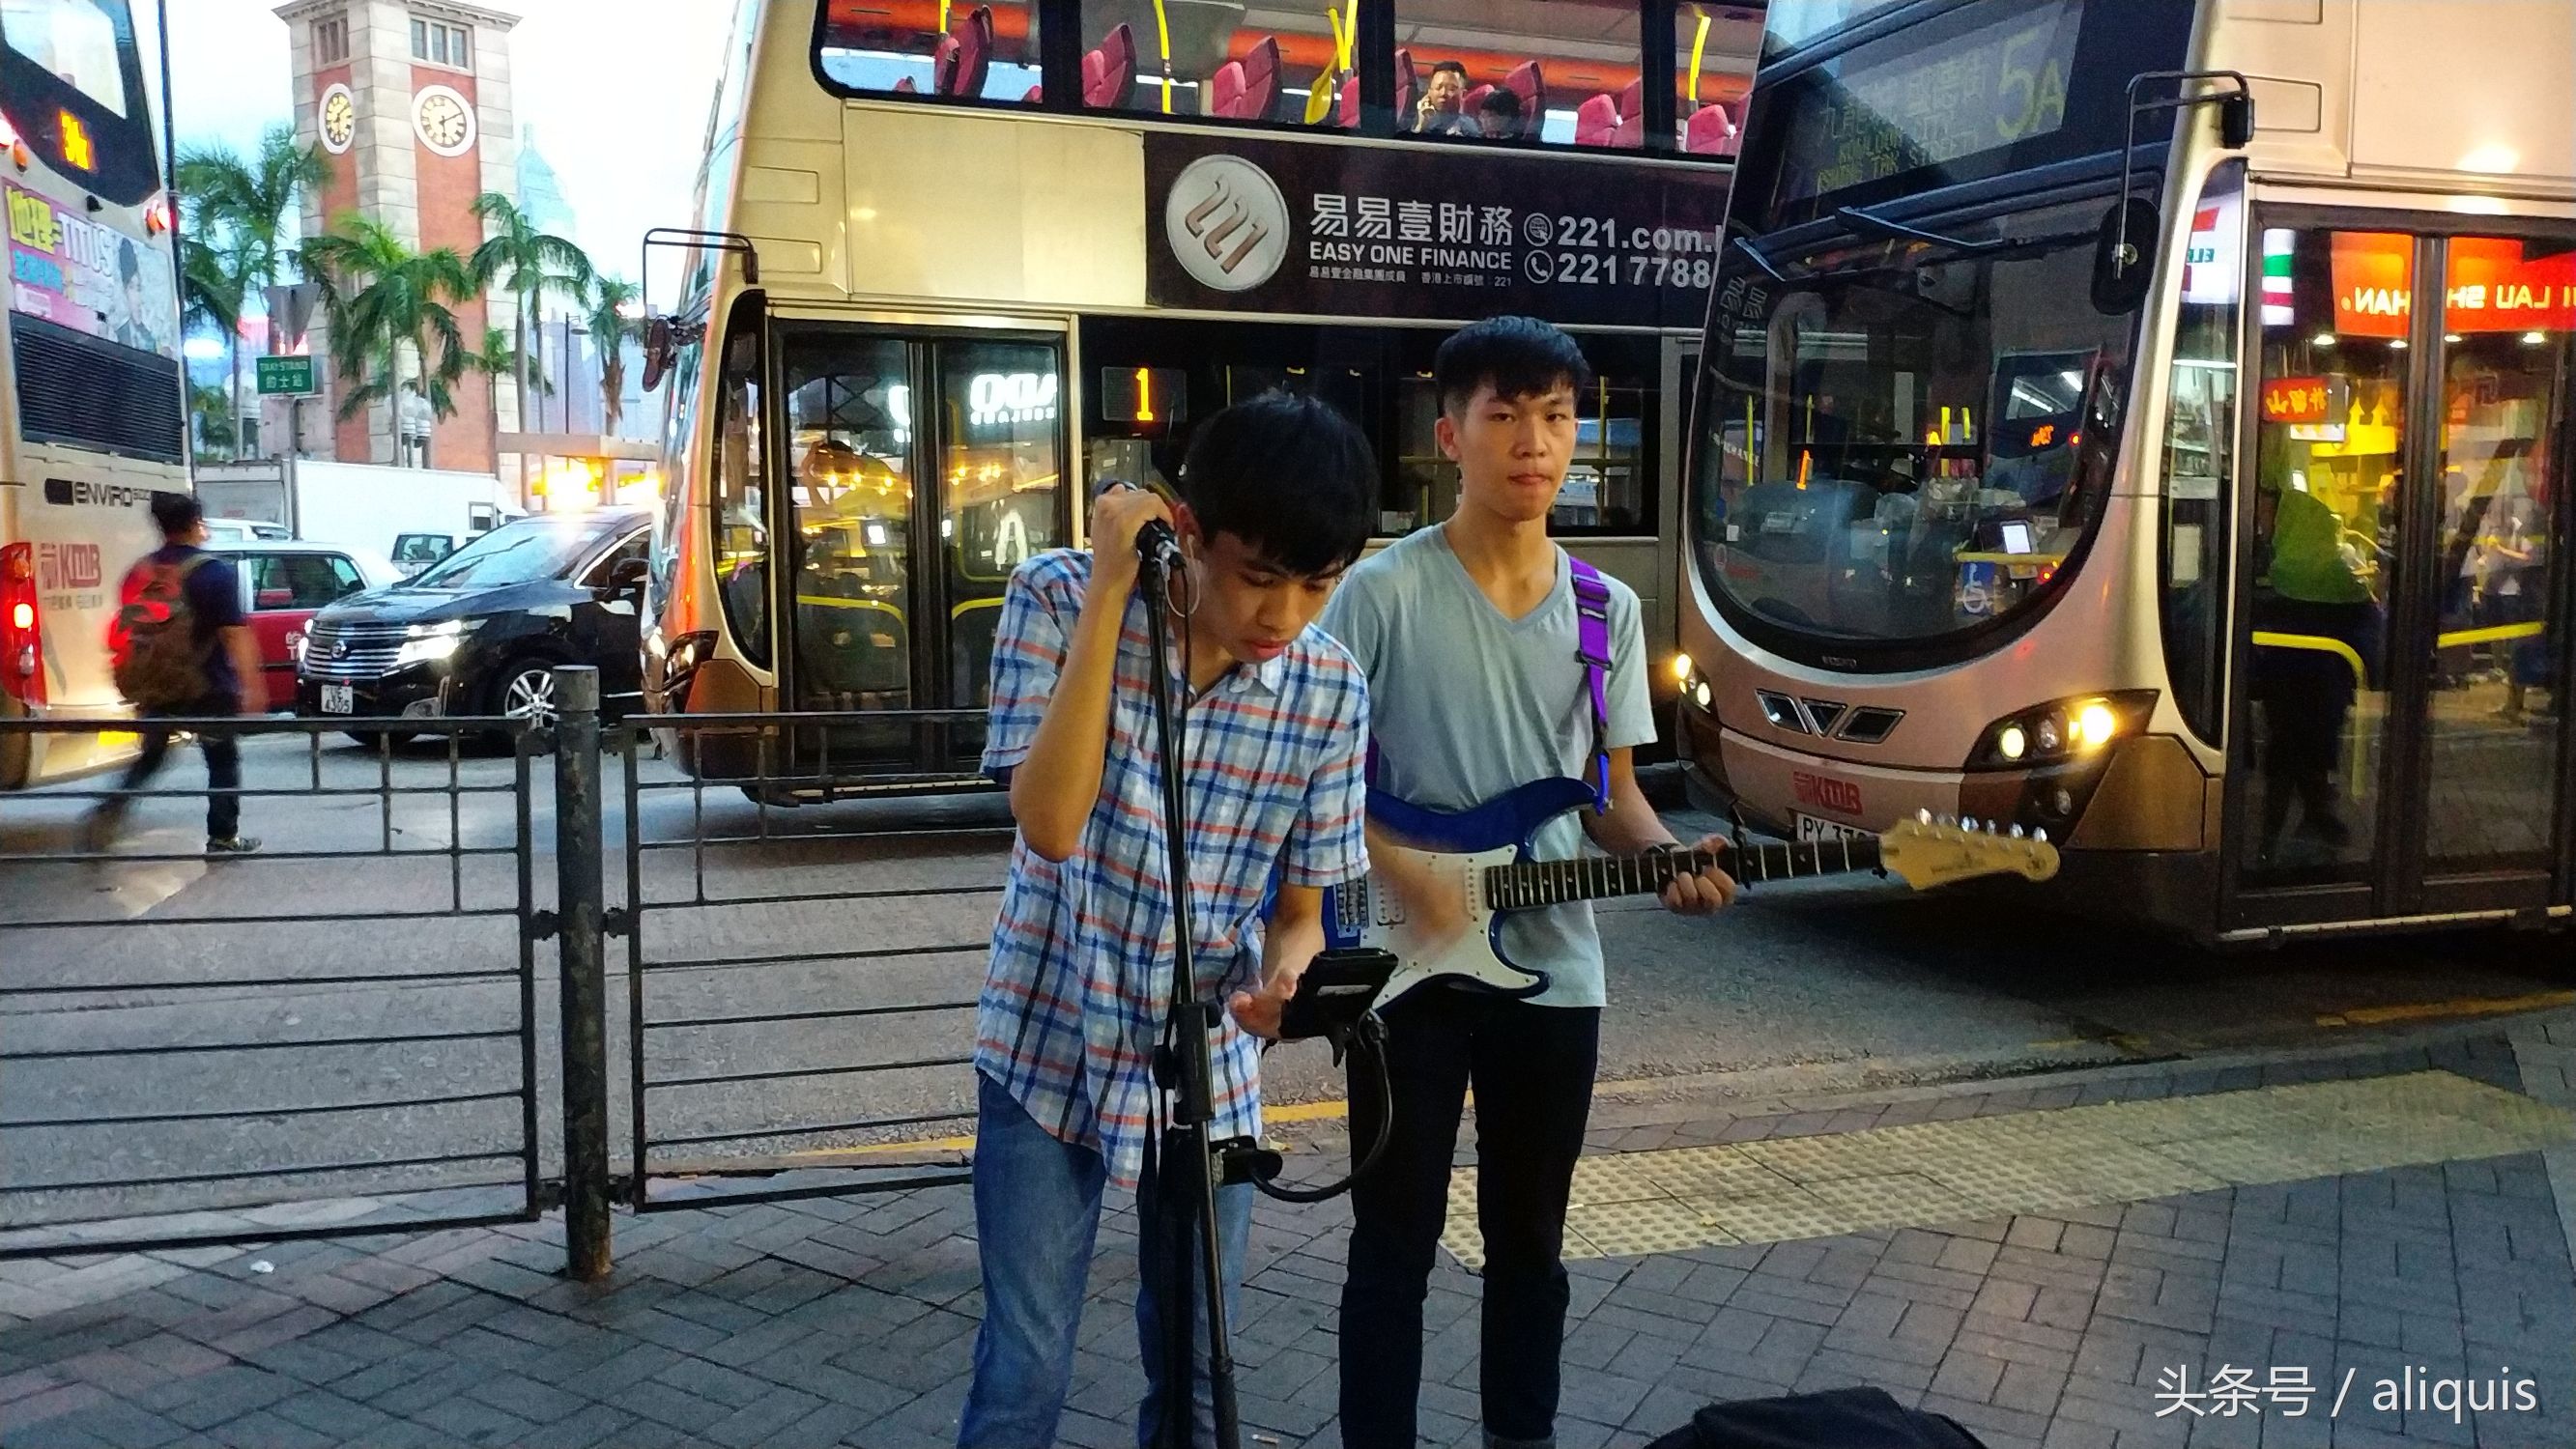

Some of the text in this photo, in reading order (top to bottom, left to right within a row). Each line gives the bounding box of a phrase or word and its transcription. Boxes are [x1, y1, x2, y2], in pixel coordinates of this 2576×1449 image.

[1995, 26, 2067, 139] 5A
[1309, 193, 1513, 246] 易易壹財務
[1309, 241, 1512, 270] EASY ONE FINANCE
[1558, 252, 1711, 289] 221 7788
[1494, 276, 1512, 287] 221
[1135, 367, 1154, 422] 1
